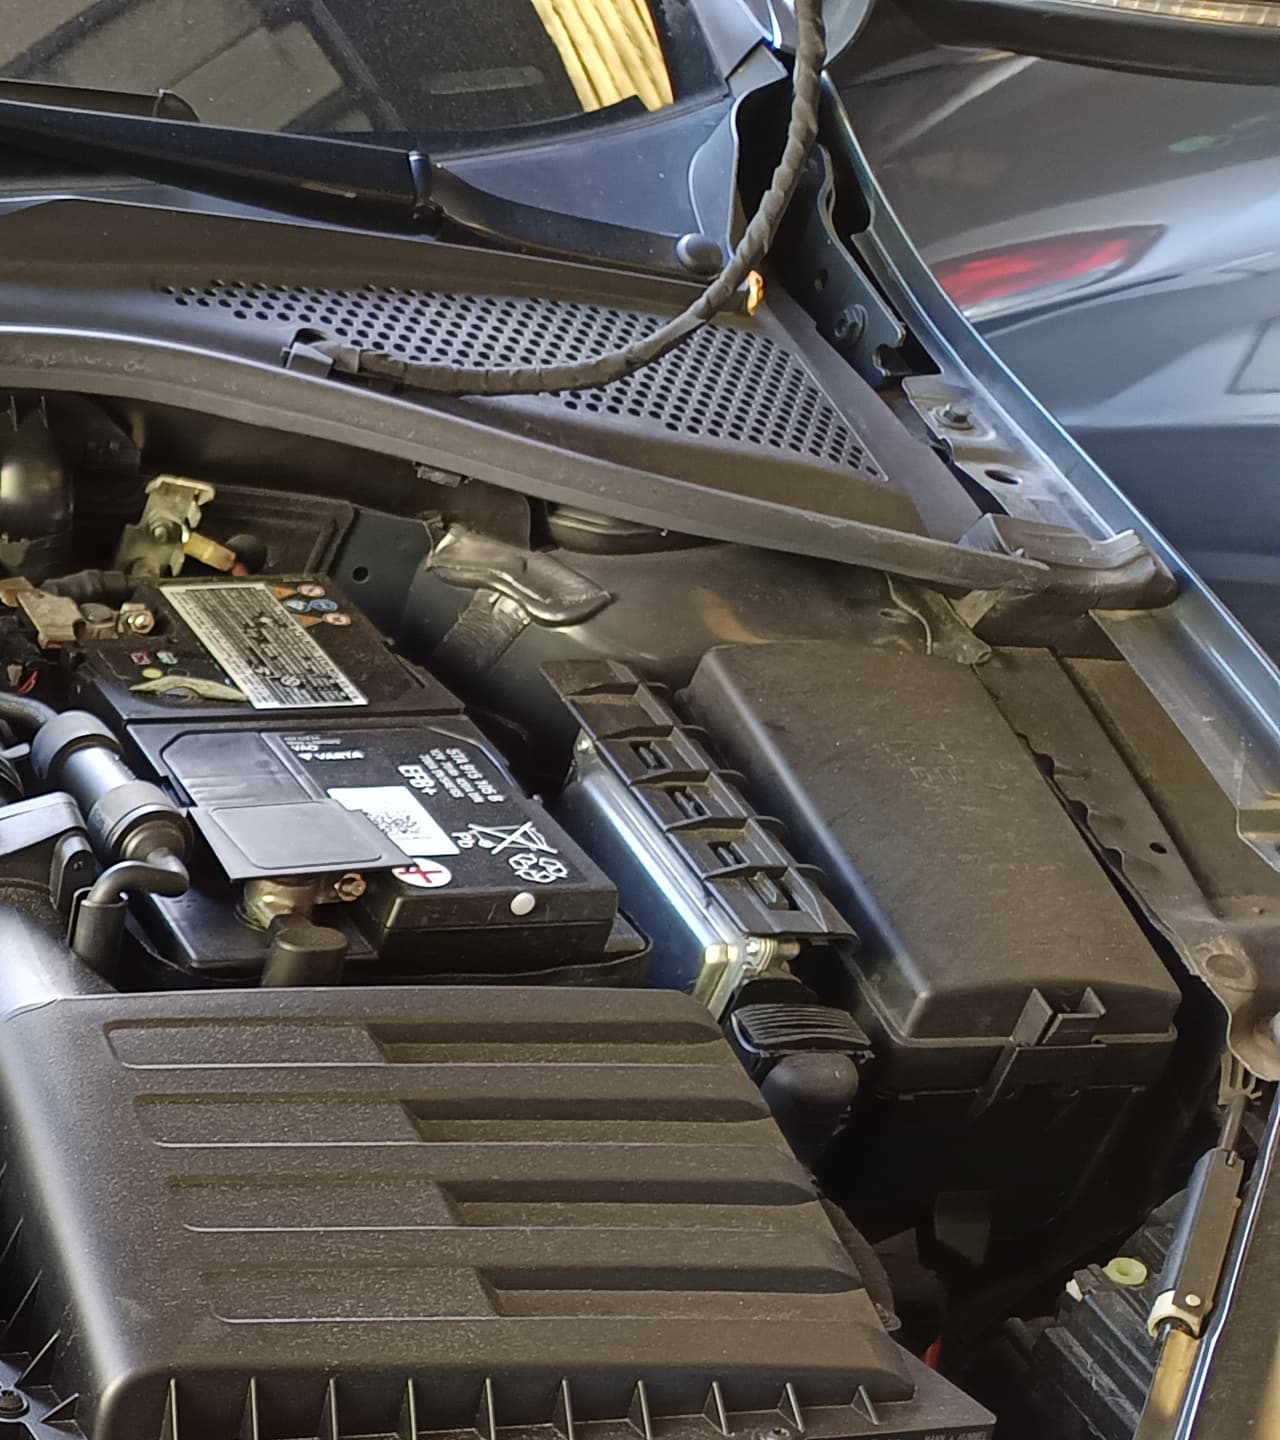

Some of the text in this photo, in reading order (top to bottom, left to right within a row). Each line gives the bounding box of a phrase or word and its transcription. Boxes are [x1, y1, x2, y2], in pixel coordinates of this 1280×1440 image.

[314, 751, 365, 761] VARTA
[397, 764, 438, 796] EFB+
[452, 831, 475, 849] Pb
